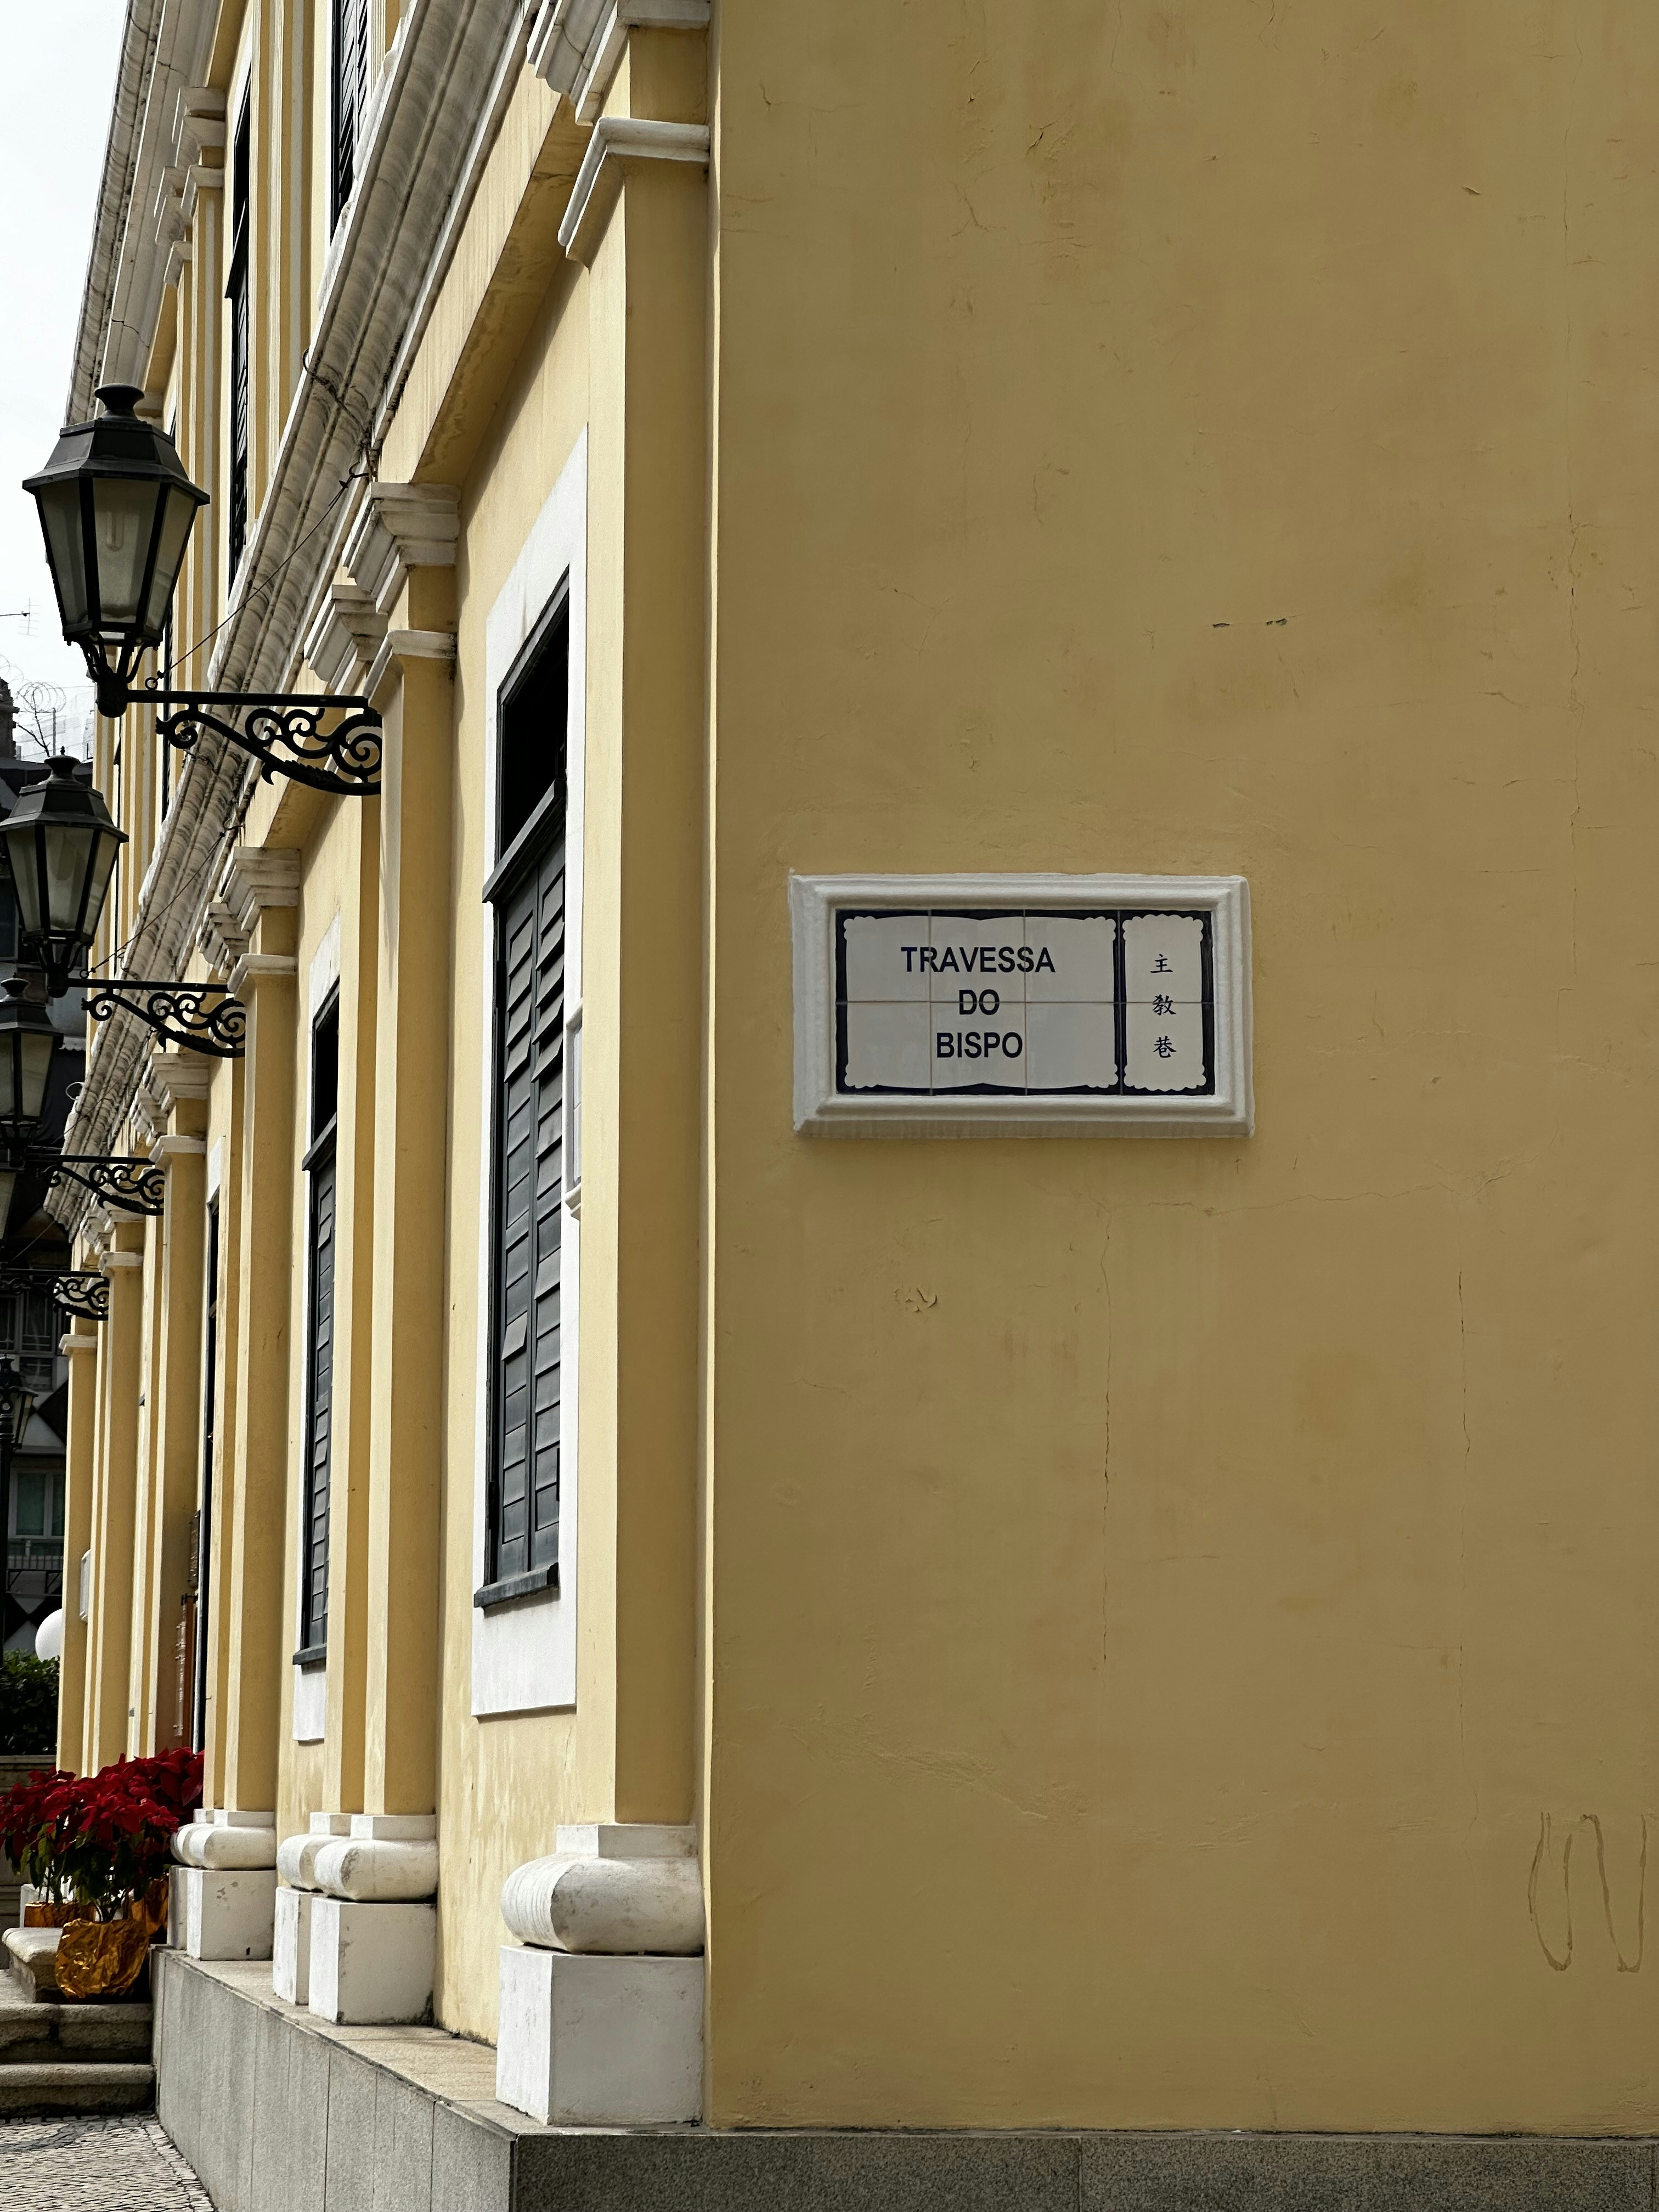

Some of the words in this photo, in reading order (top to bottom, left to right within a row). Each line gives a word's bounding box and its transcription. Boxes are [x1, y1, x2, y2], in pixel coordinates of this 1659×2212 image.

[901, 946, 1056, 973] TRAVESSA
[958, 989, 1000, 1015] DO
[936, 1032, 1023, 1058] BISPO
